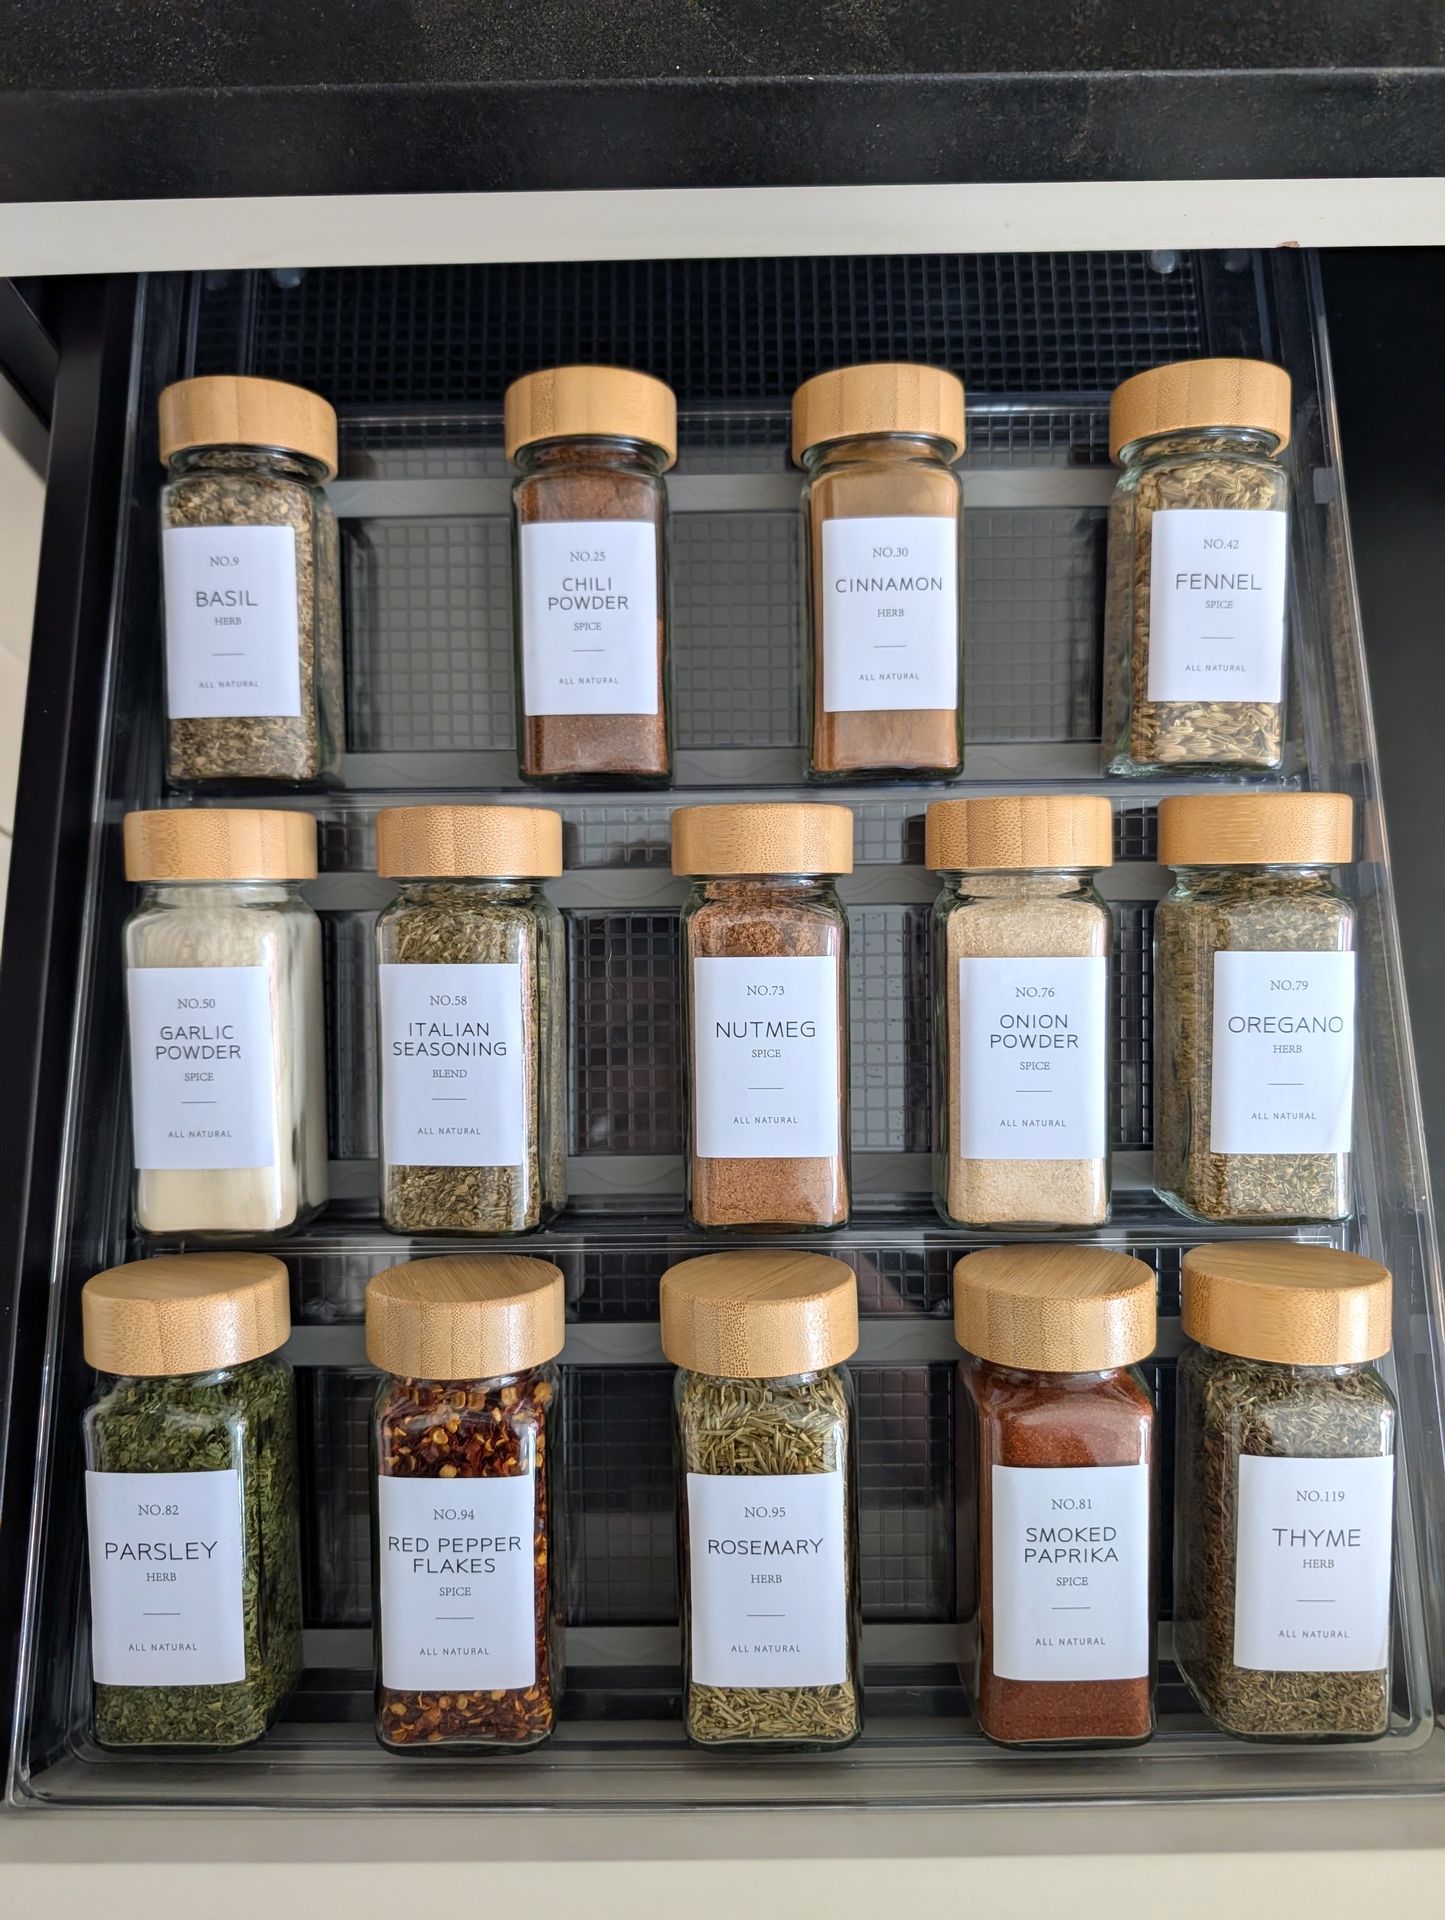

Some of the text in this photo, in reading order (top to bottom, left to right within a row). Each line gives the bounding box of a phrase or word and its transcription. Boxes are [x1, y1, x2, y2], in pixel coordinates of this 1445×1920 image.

[1203, 539, 1239, 550] NO.42
[569, 551, 605, 562] NO.25
[873, 547, 908, 558] NO.30
[209, 556, 239, 567] NO.9
[562, 577, 611, 591] CHILI
[835, 577, 942, 593] CINNAMON
[1176, 573, 1262, 590] FENNEL
[196, 590, 258, 607] BASIL
[548, 596, 628, 611] POWDER
[1205, 600, 1233, 609] SPICE
[877, 609, 904, 617] HERB
[215, 616, 242, 626] HERB
[573, 622, 602, 631] SPICE
[1186, 664, 1245, 672] ALL NATURAL
[218, 680, 259, 688] NATURAL
[578, 677, 618, 685] NATURAL
[747, 985, 784, 996] NO.73
[1270, 980, 1308, 991] NO.79
[1016, 986, 1055, 997] NO.76
[177, 998, 216, 1009] NO.50
[430, 995, 467, 1006] NO.58
[1000, 1015, 1067, 1029] ONION
[1228, 1016, 1343, 1033] OREGANO
[160, 1025, 234, 1040] GARLIC
[410, 1022, 489, 1036] ITALIAN
[716, 1021, 815, 1038] NUTMEG
[991, 1034, 1078, 1048] POWDER
[156, 1045, 241, 1060] POWDER
[393, 1042, 506, 1056] SEASONING
[752, 1049, 781, 1058] SPICE
[1273, 1044, 1302, 1053] HERB
[1020, 1061, 1050, 1070] SPICE
[185, 1072, 214, 1081] SPICE
[432, 1069, 467, 1078] BLEND
[755, 1116, 798, 1124] NATURAL
[1022, 1120, 1066, 1128] NATURAL
[189, 1130, 232, 1138] NATURAL
[439, 1128, 480, 1136] NATURAL
[1297, 1490, 1345, 1502] NO.119
[138, 1504, 179, 1516] NO.82
[1052, 1499, 1091, 1510] NO.81
[433, 1509, 475, 1520] NO.94
[744, 1507, 785, 1518] NO.95
[1026, 1527, 1116, 1542] SMOKED
[1272, 1528, 1360, 1547] THYME
[389, 1536, 521, 1552] RED PEPPER
[708, 1538, 823, 1555] ROSEMARY
[105, 1541, 217, 1560] PARSLEY
[1025, 1547, 1118, 1563] PAPRIKA
[414, 1558, 495, 1573] FLAKES
[1303, 1559, 1334, 1568] HERB
[147, 1572, 176, 1582] HERB
[751, 1574, 782, 1583] HERB
[1056, 1577, 1088, 1587] SPICE
[440, 1587, 471, 1597] SPICE
[1279, 1630, 1348, 1638] ALL NATURAL
[129, 1643, 198, 1651] ALL NATURAL
[1035, 1637, 1105, 1646] ALL NATURAL
[731, 1645, 800, 1653] ALL NATURAL
